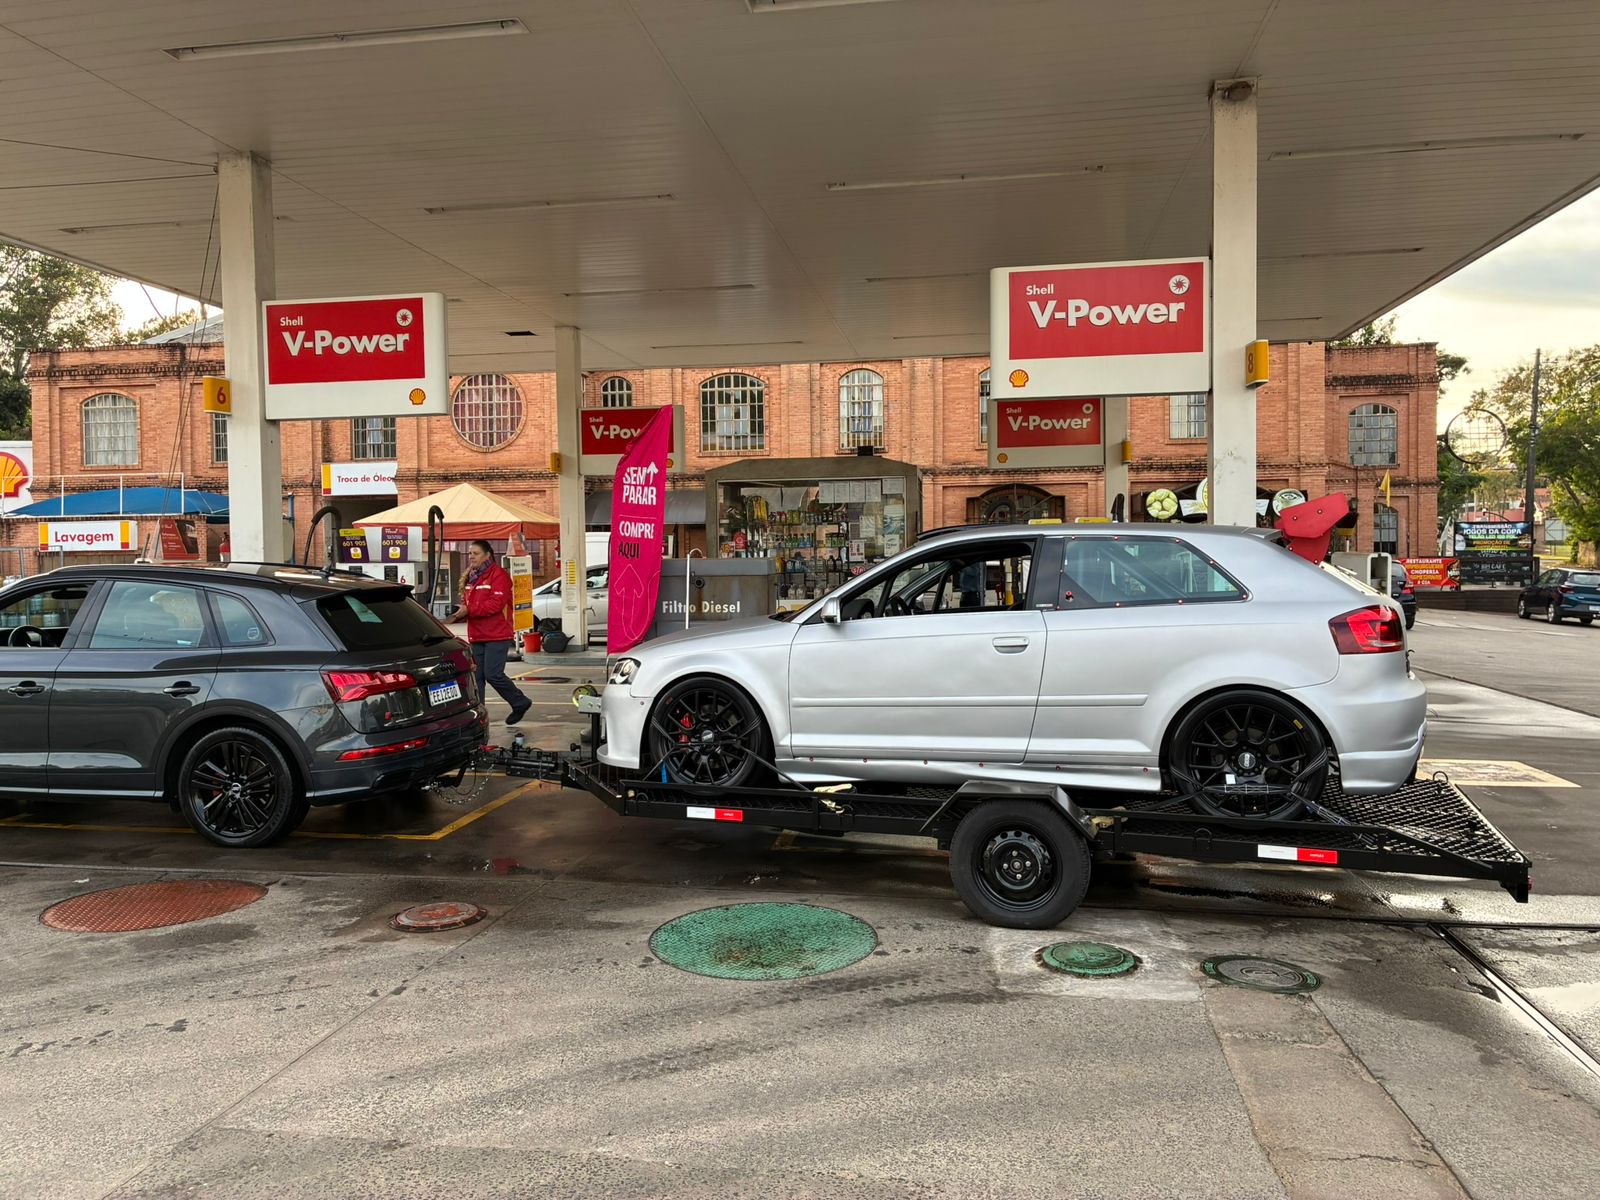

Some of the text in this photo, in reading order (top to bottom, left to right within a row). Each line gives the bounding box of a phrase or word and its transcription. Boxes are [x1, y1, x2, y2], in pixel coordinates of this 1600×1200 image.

[1025, 284, 1054, 296] Shell
[279, 316, 304, 327] Shell
[1027, 298, 1186, 329] V-Power
[281, 330, 410, 356] V-Power
[1247, 352, 1255, 374] 8
[216, 386, 227, 405] 6
[1005, 407, 1022, 415] Shell
[1007, 415, 1091, 431] V-Power
[337, 475, 359, 483] Troca
[360, 474, 371, 482] de
[622, 466, 647, 485] SEM
[622, 485, 657, 506] PARAR
[54, 530, 114, 545] Lavagem
[619, 520, 655, 539] COMPRE
[618, 541, 640, 559] AQUI
[400, 575, 406, 584] 6
[662, 600, 741, 613] Filtro Diesel
